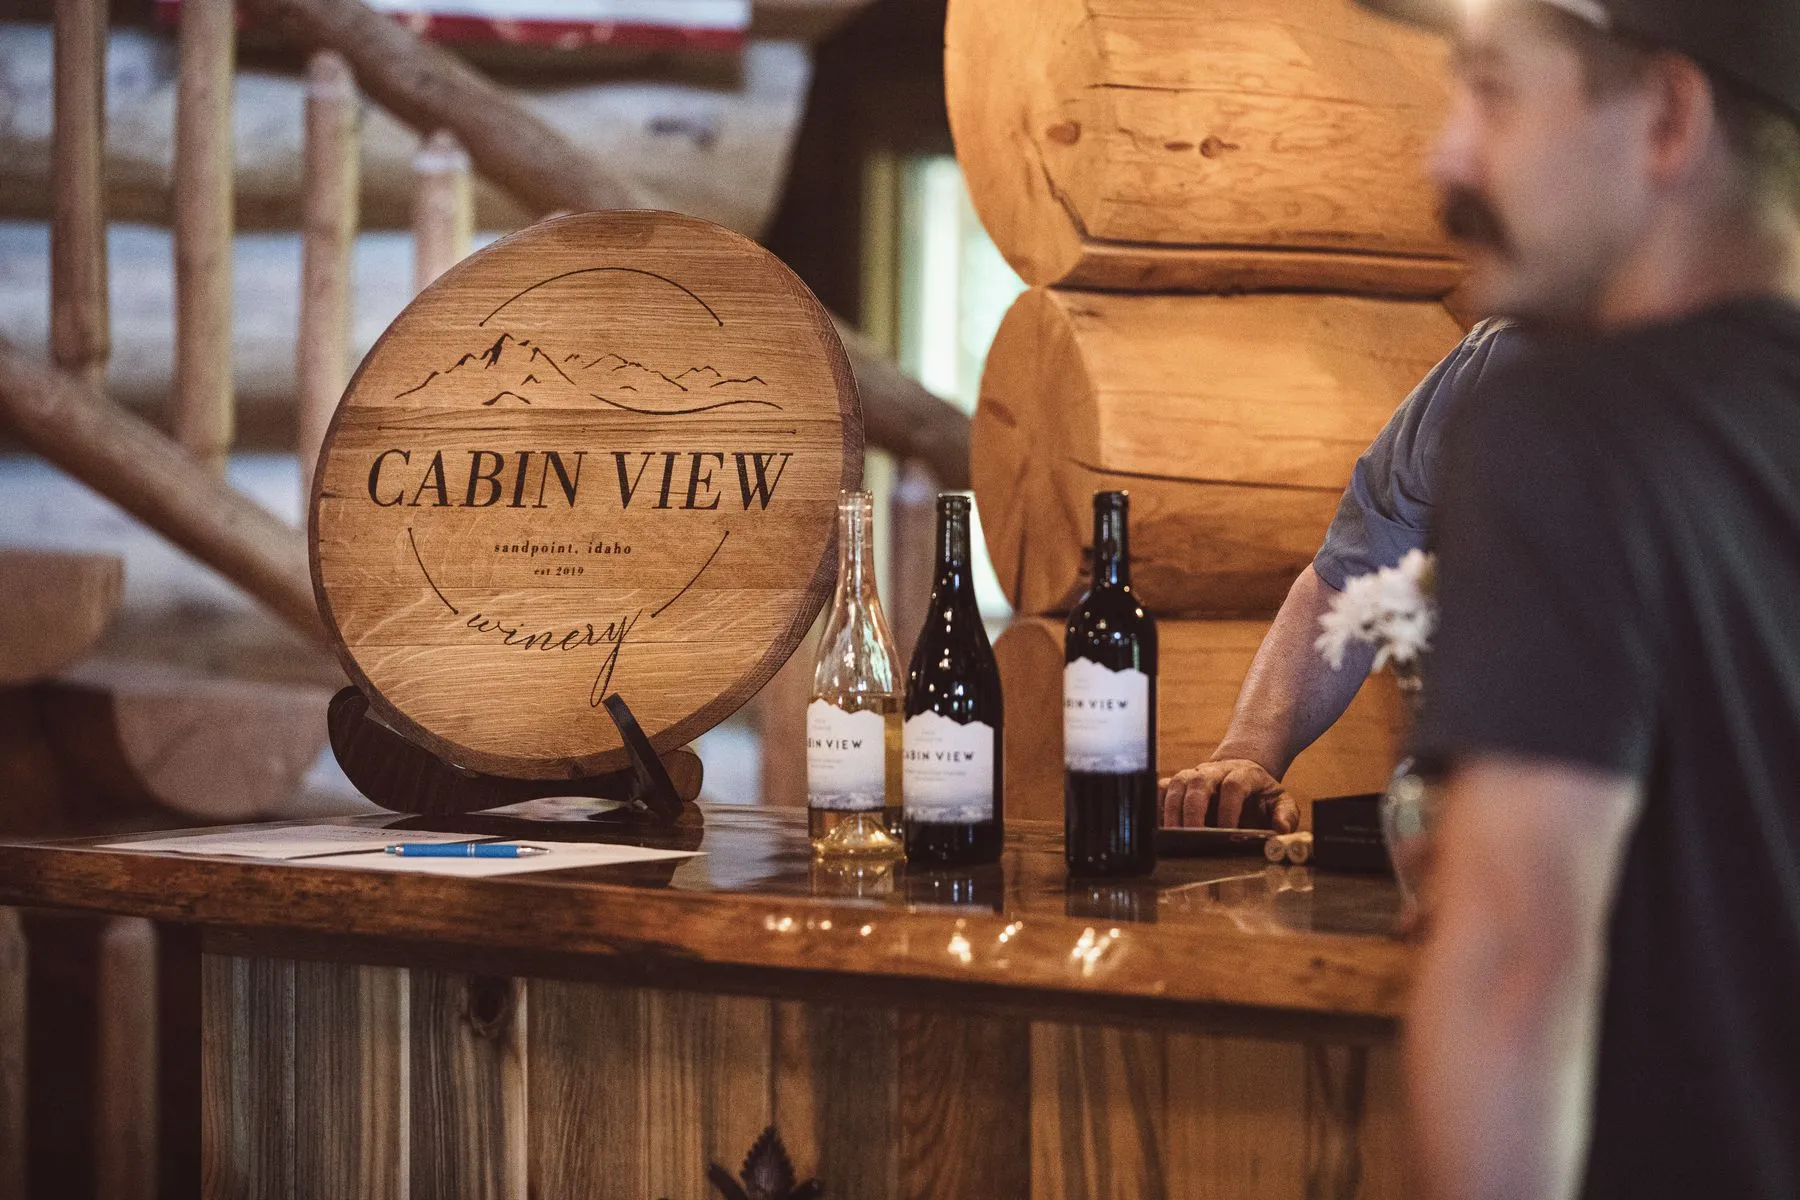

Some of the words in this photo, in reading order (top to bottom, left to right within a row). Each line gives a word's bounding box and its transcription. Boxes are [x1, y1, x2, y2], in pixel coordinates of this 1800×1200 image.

[367, 448, 588, 509] CABIN
[610, 451, 794, 511] VIEW
[494, 540, 579, 558] sandpoint,
[587, 541, 632, 555] idaho
[534, 566, 551, 576] est
[555, 566, 584, 577] 2019
[466, 608, 644, 708] winery
[1089, 698, 1129, 711] VIEW
[826, 738, 863, 751] VIEW
[936, 750, 975, 764] VIEW
